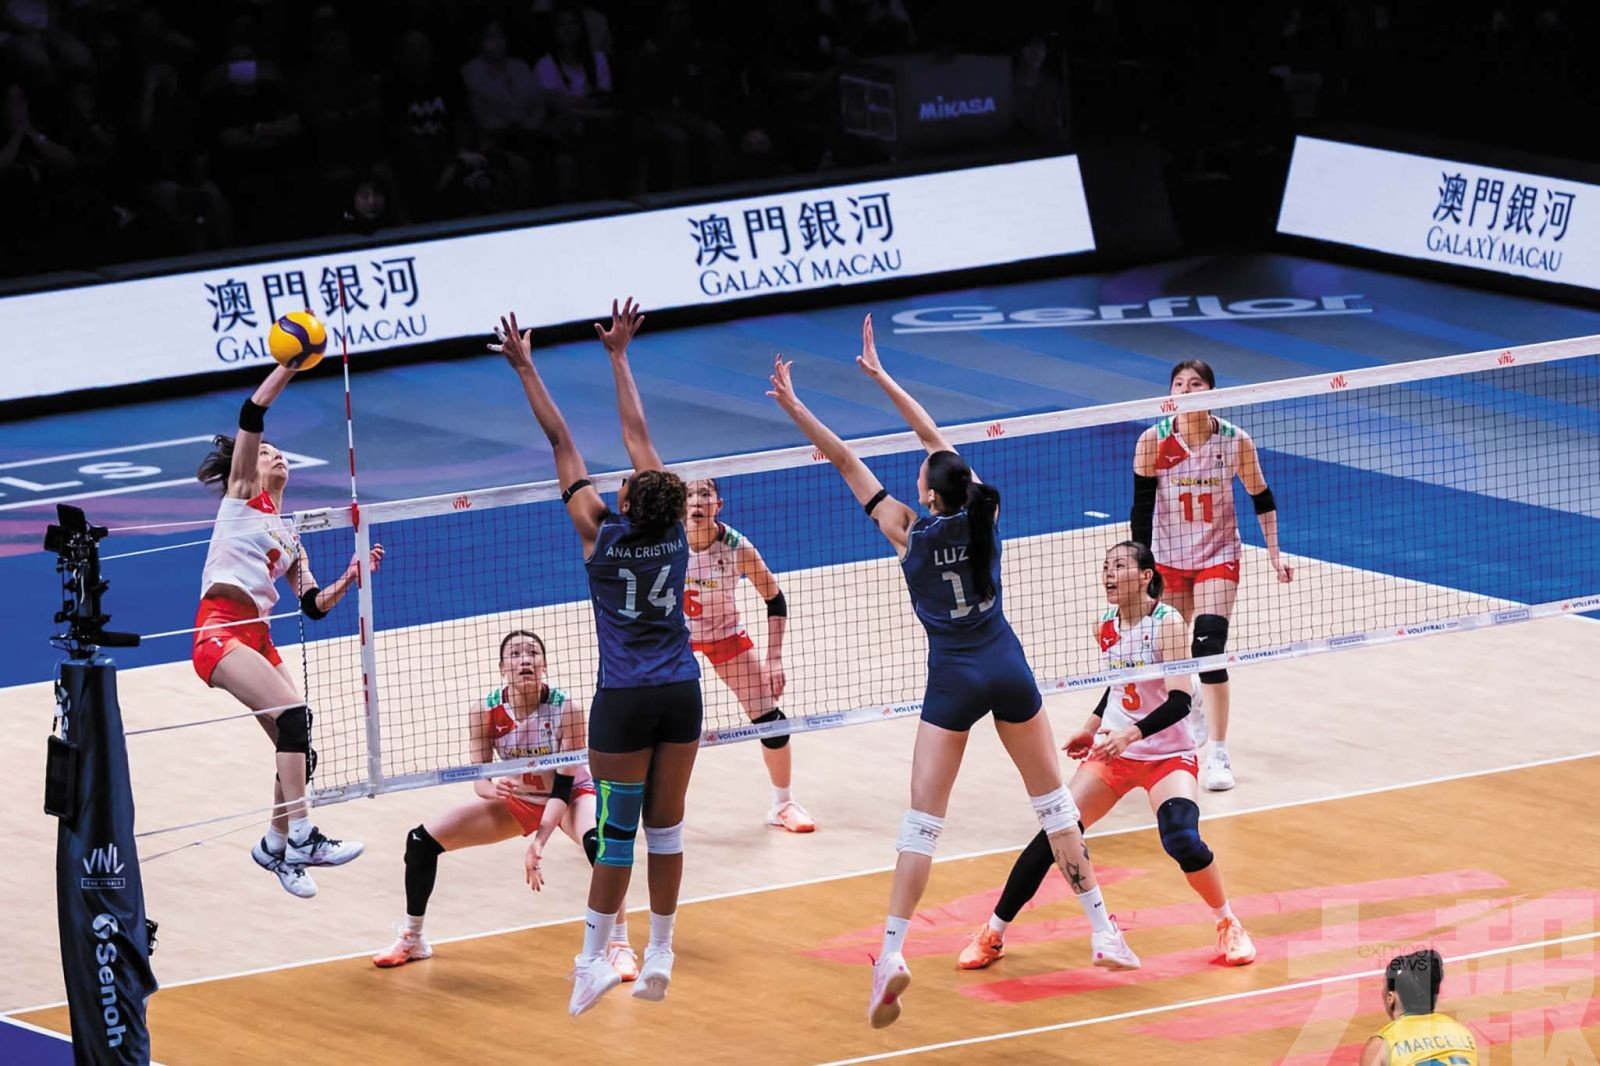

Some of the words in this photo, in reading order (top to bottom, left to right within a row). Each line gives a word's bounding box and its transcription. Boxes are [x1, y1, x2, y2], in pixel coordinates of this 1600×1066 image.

[1432, 172, 1577, 243] 澳門銀河
[687, 193, 894, 266] 澳門銀河
[1426, 225, 1500, 261] GALAXY
[1499, 242, 1563, 272] MACAU
[700, 258, 804, 297] GALAXY
[811, 249, 902, 281] MACAU
[204, 257, 420, 333] 澳門銀河
[891, 294, 1367, 327] Gerflor
[216, 336, 272, 364] GAL
[333, 315, 428, 347] MACAU
[1329, 374, 1348, 390] VNL
[1160, 400, 1178, 413] VNL
[986, 422, 1005, 438] VNL
[452, 495, 472, 510] VNL
[1178, 492, 1213, 523] 11
[606, 546, 632, 558] ANA
[635, 539, 684, 558] CRISTINA
[934, 545, 969, 567] LUZ
[618, 565, 677, 619] 14
[683, 590, 703, 617] 6
[1121, 682, 1141, 711] 3
[82, 843, 125, 874] VNL
[95, 942, 127, 1048] Senoh
